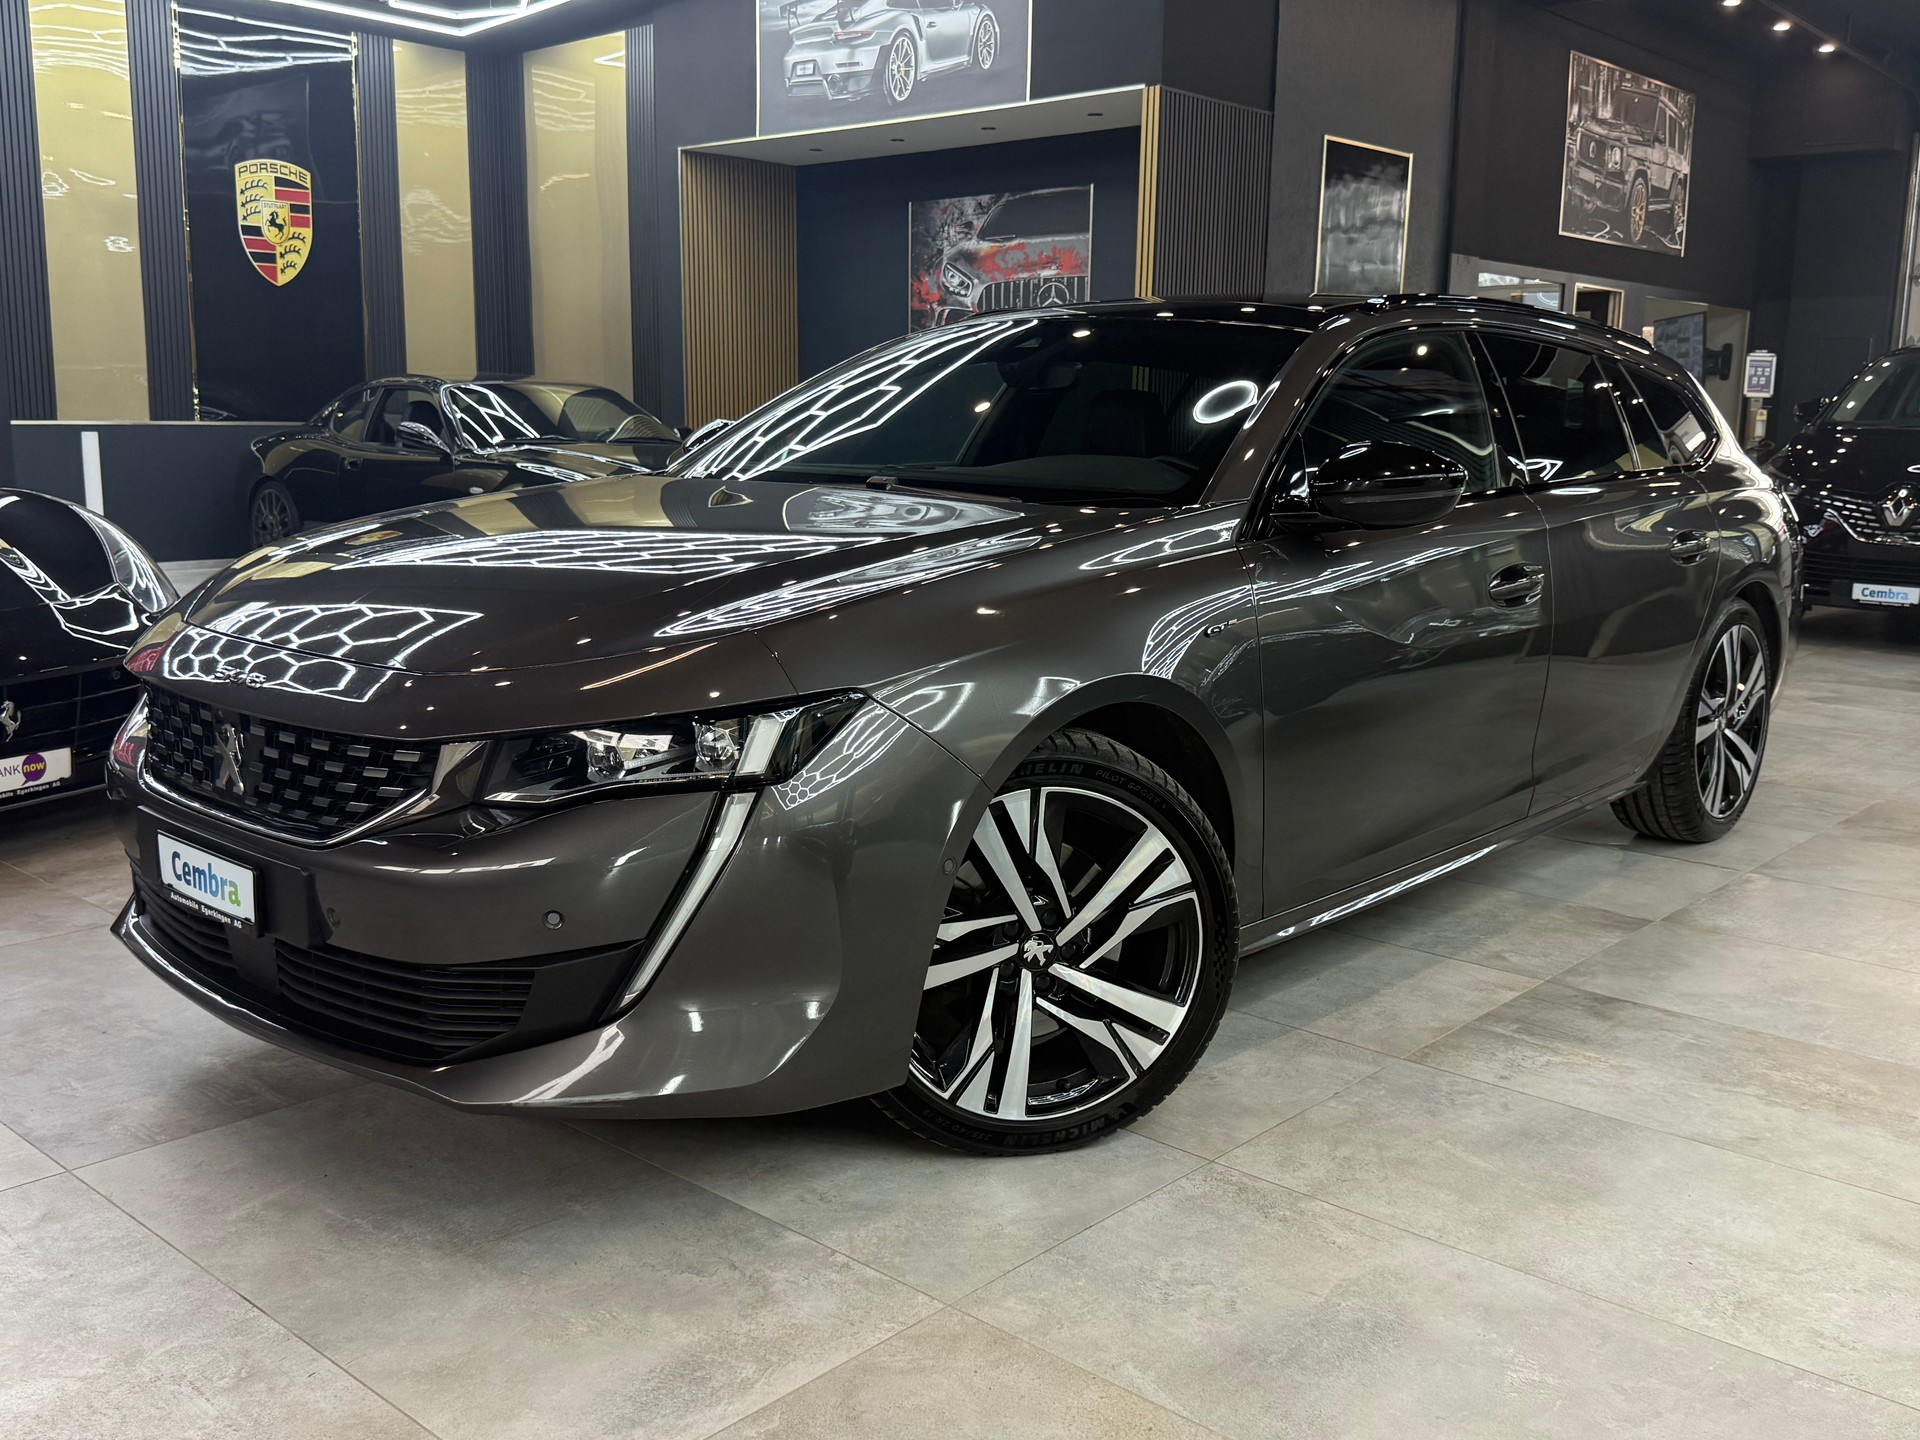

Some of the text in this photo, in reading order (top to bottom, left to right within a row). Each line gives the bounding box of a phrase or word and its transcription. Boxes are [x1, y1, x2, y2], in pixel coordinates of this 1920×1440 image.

[238, 162, 308, 184] PORSCHE
[1861, 587, 1909, 600] Cembra
[23, 762, 45, 773] now
[1095, 769, 1125, 785] PILOT
[172, 851, 241, 907] Cembra
[170, 892, 242, 928] Automobile Egerkingen AG
[1003, 1117, 1106, 1146] MICHELIN
